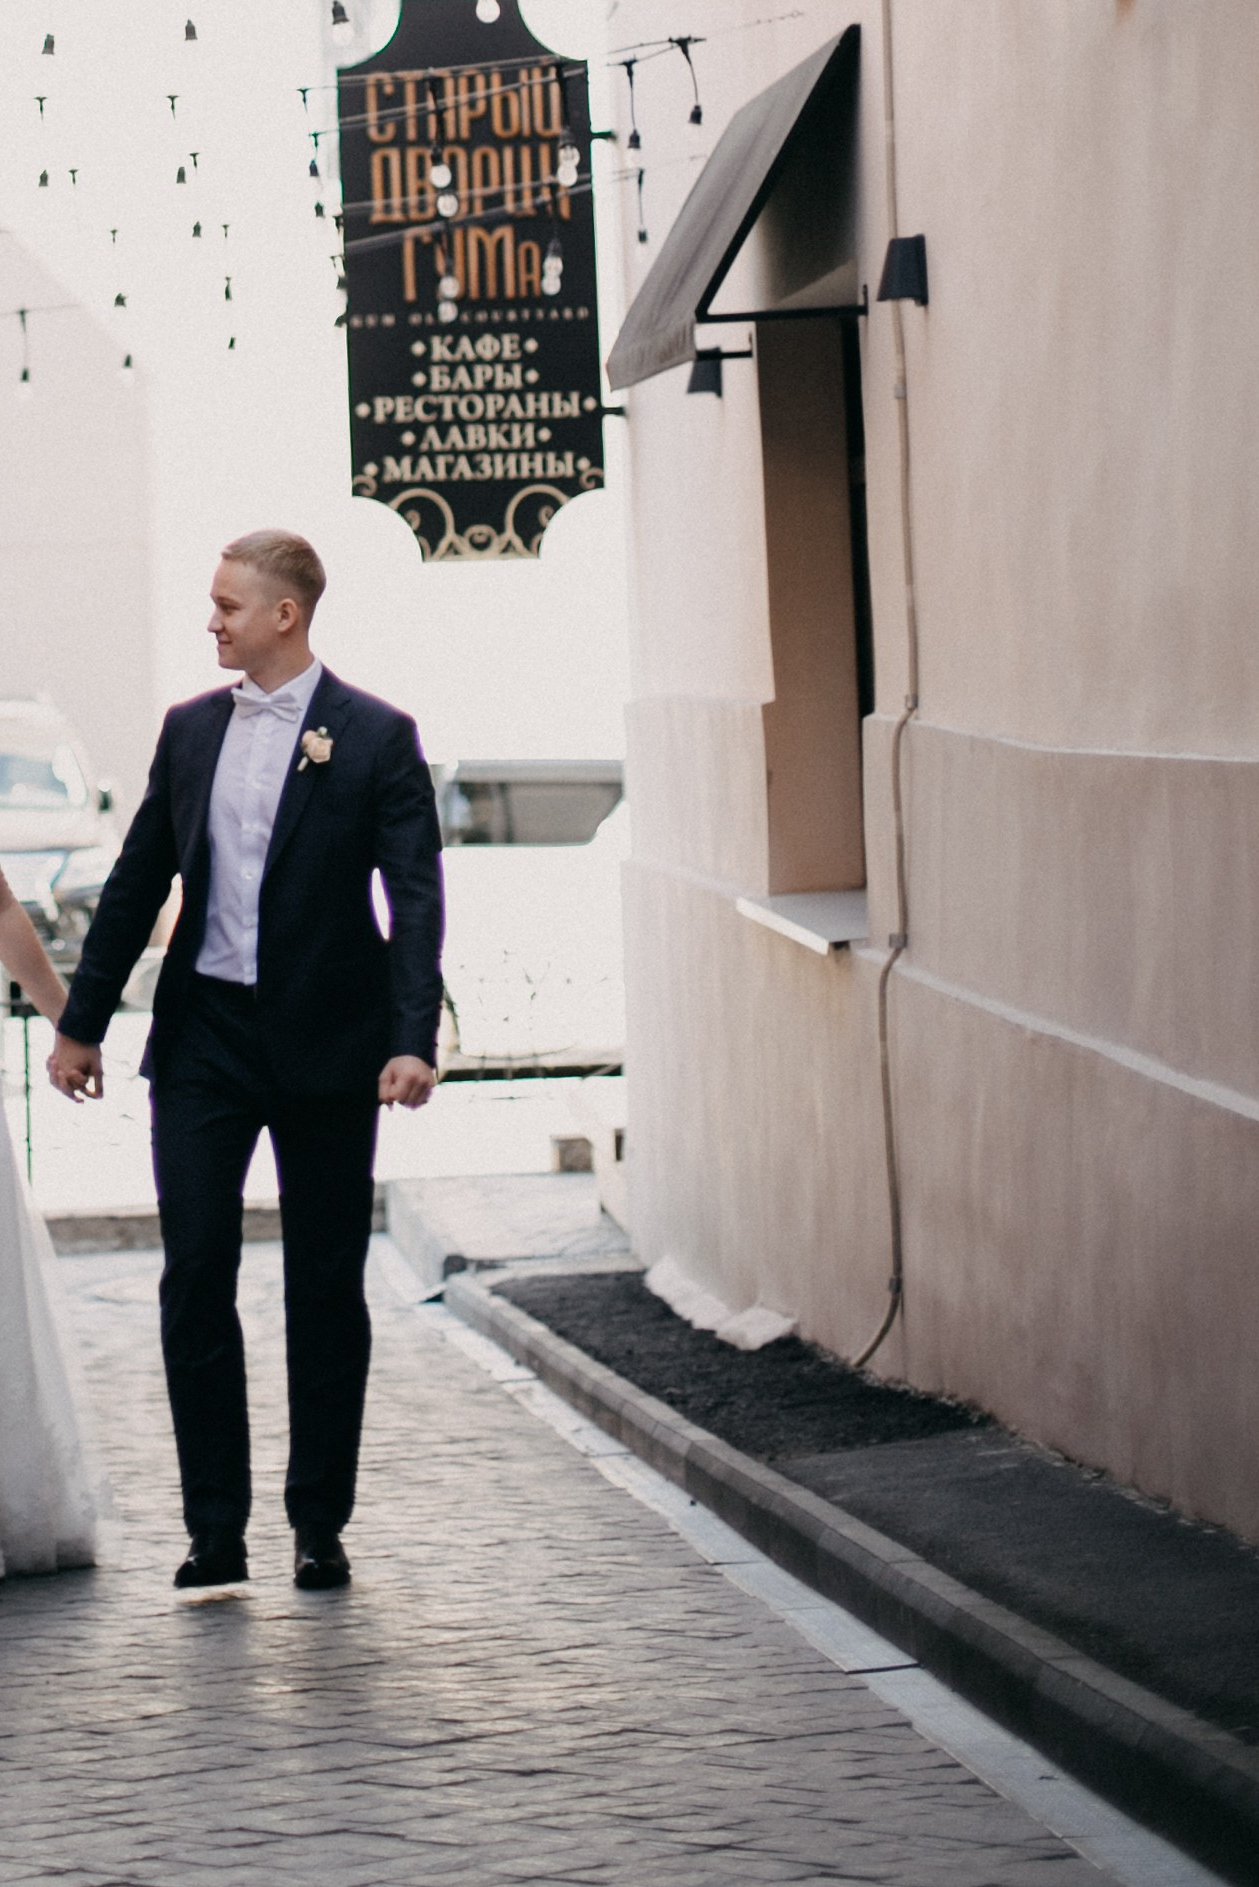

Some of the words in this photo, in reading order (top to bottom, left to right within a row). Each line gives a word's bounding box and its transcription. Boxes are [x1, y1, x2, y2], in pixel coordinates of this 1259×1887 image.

[366, 59, 565, 143] СТАРЫЙ
[429, 333, 522, 362] КАФЕ
[428, 363, 524, 392] БАРЫ
[372, 391, 582, 424] РЕСТОРАНЫ
[418, 423, 537, 452] ЛАВКИ
[382, 452, 576, 483] МАГАЗИНЫ
